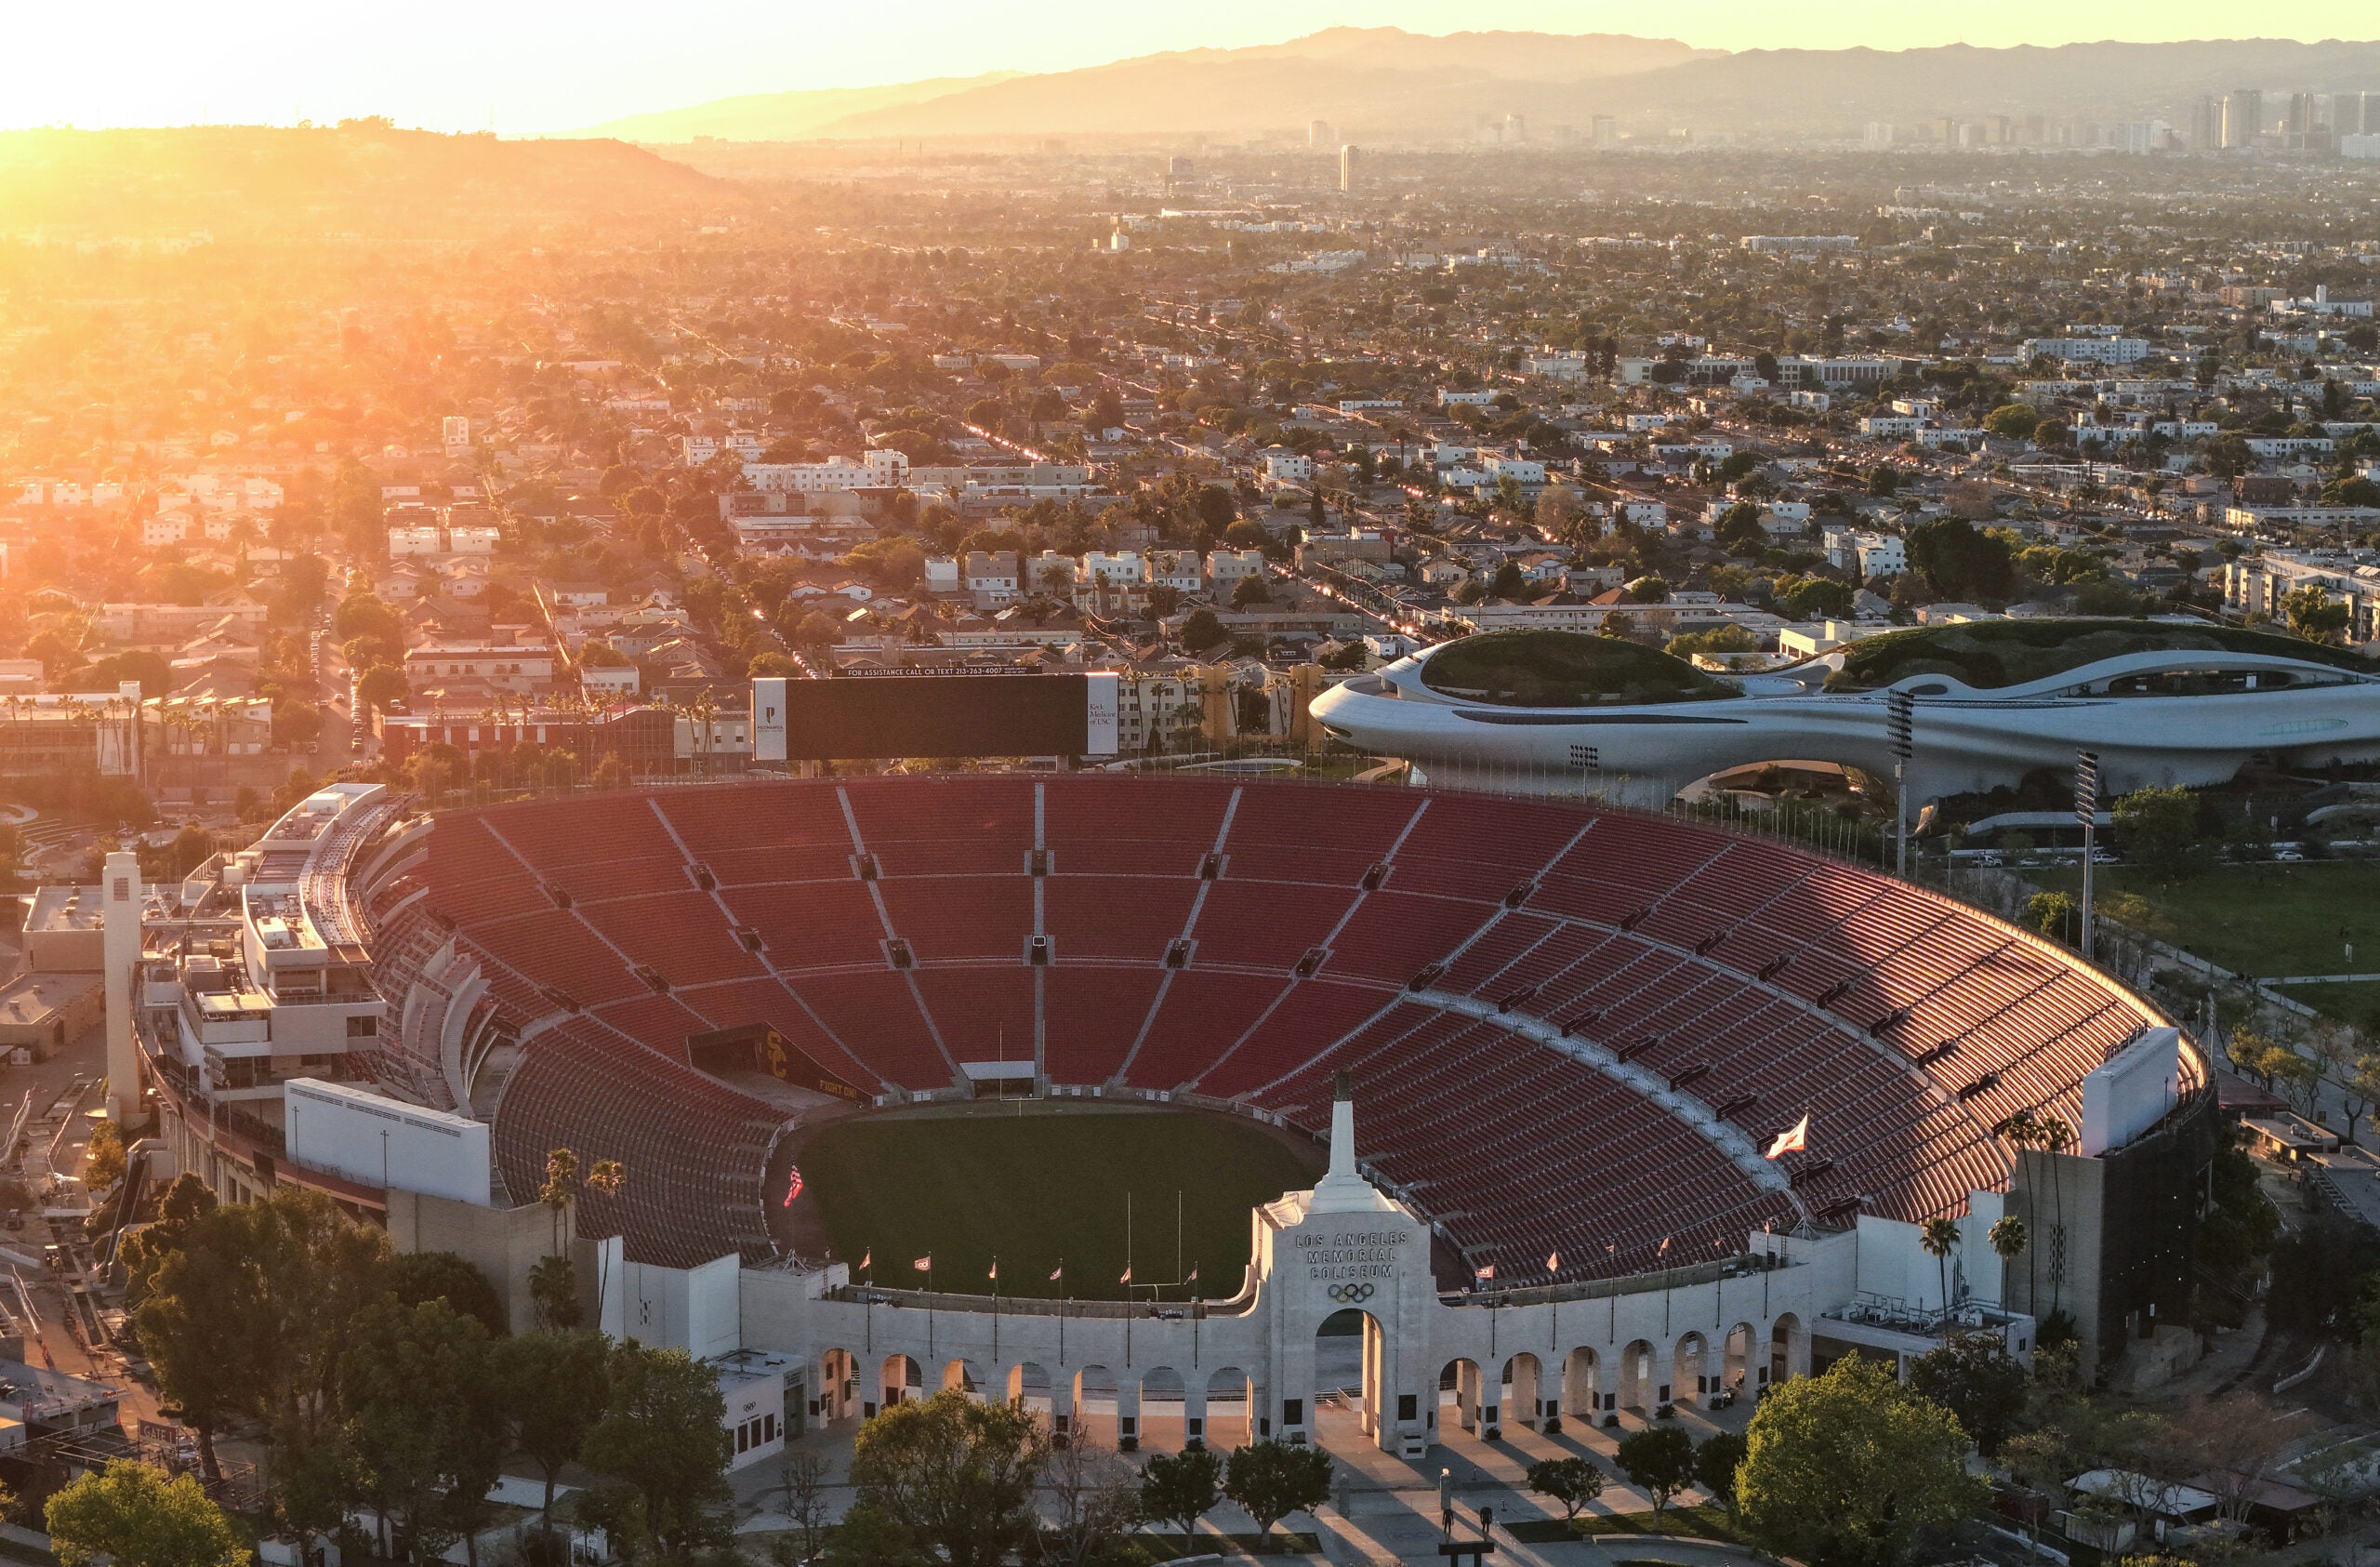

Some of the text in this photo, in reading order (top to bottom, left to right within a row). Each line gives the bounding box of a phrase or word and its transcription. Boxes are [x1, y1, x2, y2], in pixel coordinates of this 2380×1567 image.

[820, 1080, 843, 1095] FIGHT
[1296, 1232, 1408, 1248] LOS ANGELES
[1308, 1248, 1396, 1264] MEMORIAL
[1310, 1265, 1393, 1280] COLISEUM
[143, 1425, 165, 1441] GATE
